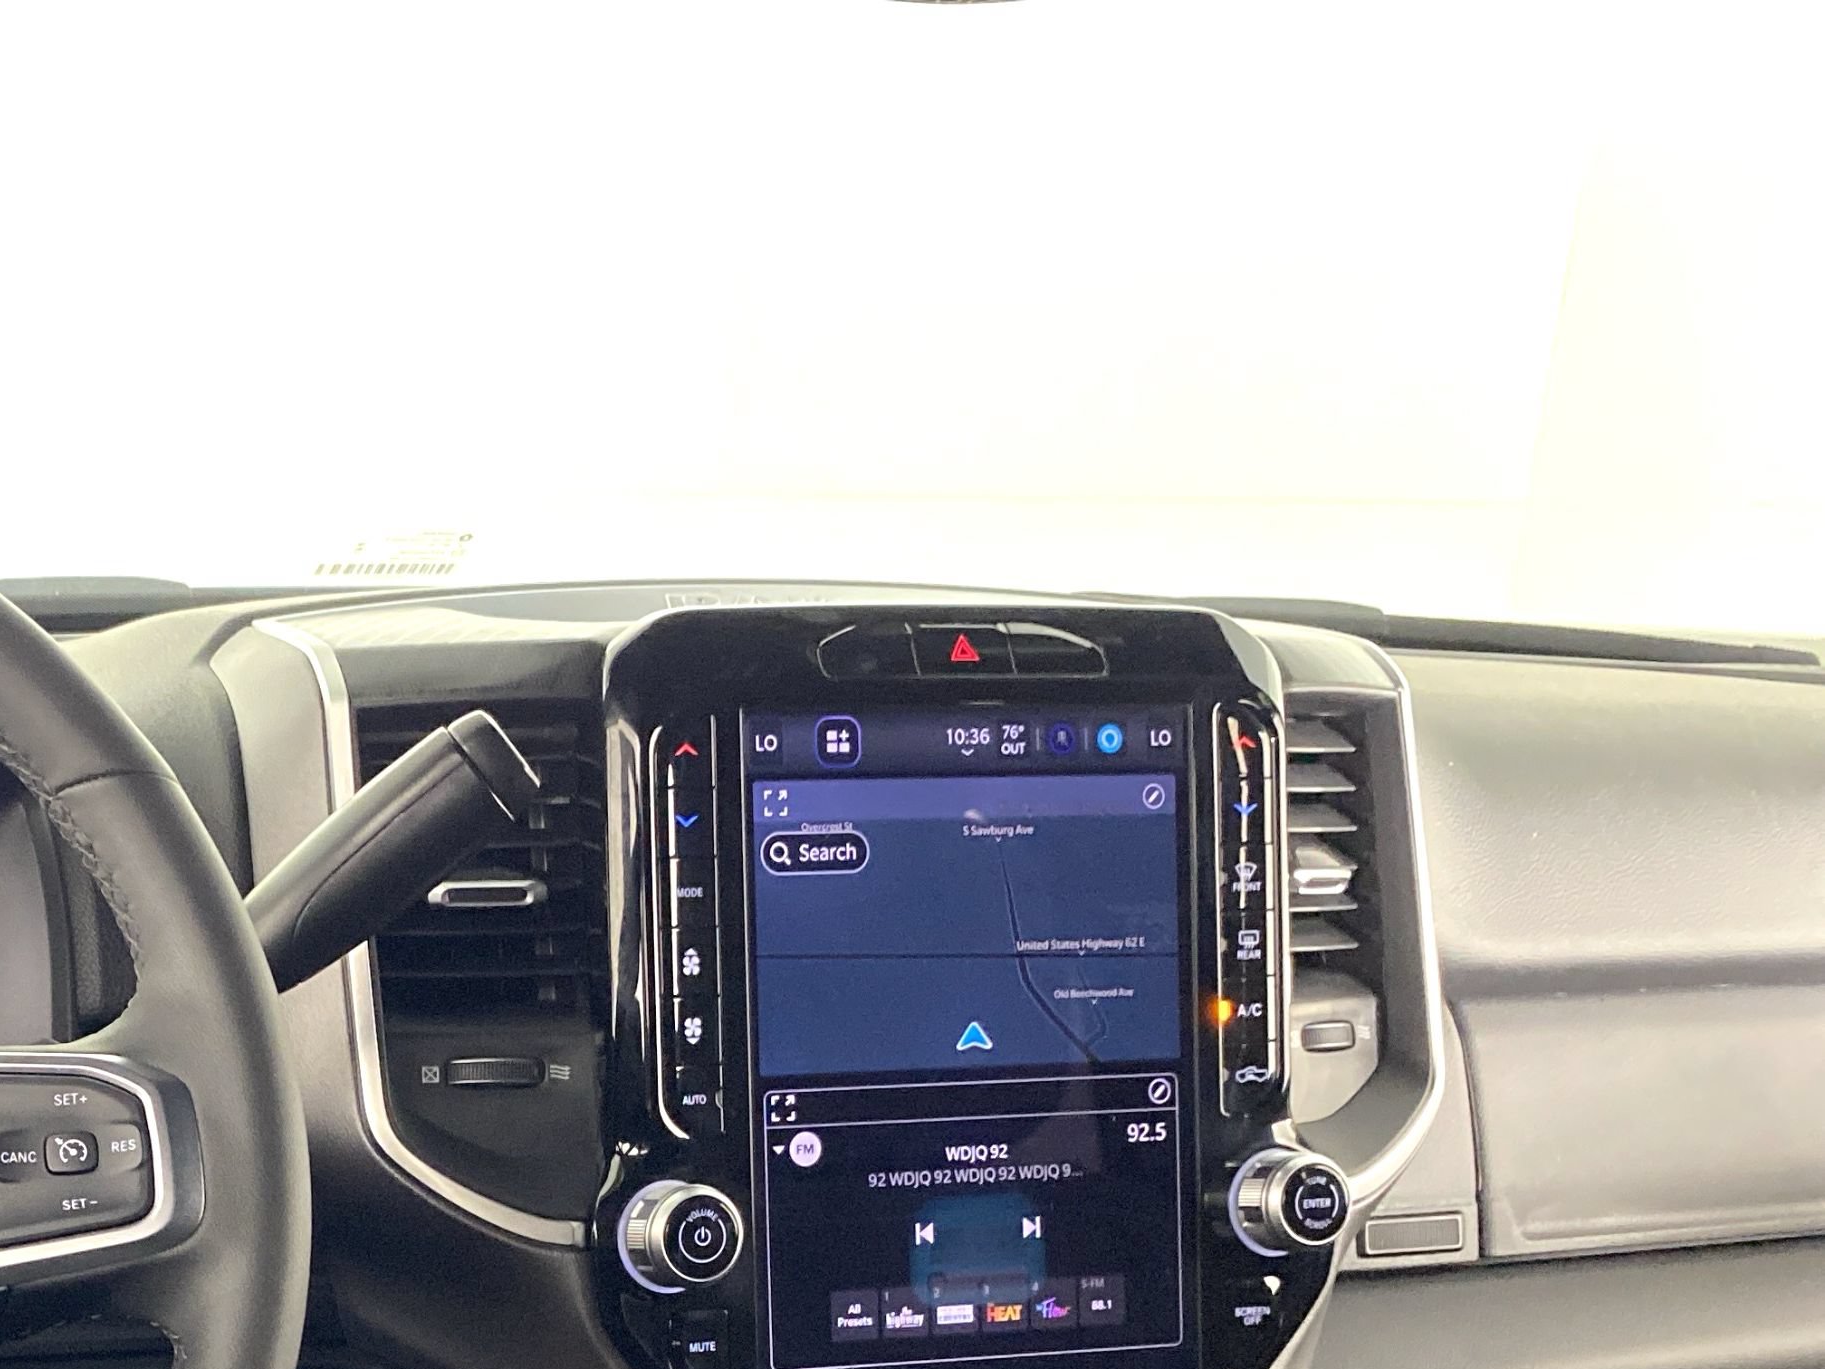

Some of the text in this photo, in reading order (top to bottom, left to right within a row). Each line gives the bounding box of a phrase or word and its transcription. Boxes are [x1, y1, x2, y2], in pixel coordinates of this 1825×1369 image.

[754, 735, 778, 752] LO
[946, 728, 991, 746] 10:36
[1150, 729, 1172, 747] LO
[1000, 742, 1025, 755] OUT
[1015, 825, 1034, 835] Ave
[798, 843, 857, 862] Search
[676, 887, 703, 898] MODE
[1016, 940, 1049, 951] United
[1081, 938, 1123, 950] Highway
[1237, 948, 1262, 960] REAR
[1237, 1003, 1262, 1017] A/C
[682, 1094, 707, 1105] AUTO
[1126, 1122, 1167, 1143] 92.5
[111, 1140, 136, 1153] RES
[796, 1144, 814, 1155] FM
[0, 1151, 37, 1164] CANC
[945, 1144, 1008, 1163] WDJQ 92
[868, 1172, 886, 1188] 92
[888, 1171, 931, 1189] WDJQ
[934, 1169, 952, 1184] 92
[954, 1167, 996, 1184] WDJQ
[999, 1166, 1016, 1181] 92
[1018, 1164, 1060, 1181] WDJQ
[686, 1208, 719, 1223] VOLUME
[986, 1304, 1023, 1322] HEAT
[837, 1316, 873, 1328] Presets
[689, 1341, 716, 1352] MUTE
